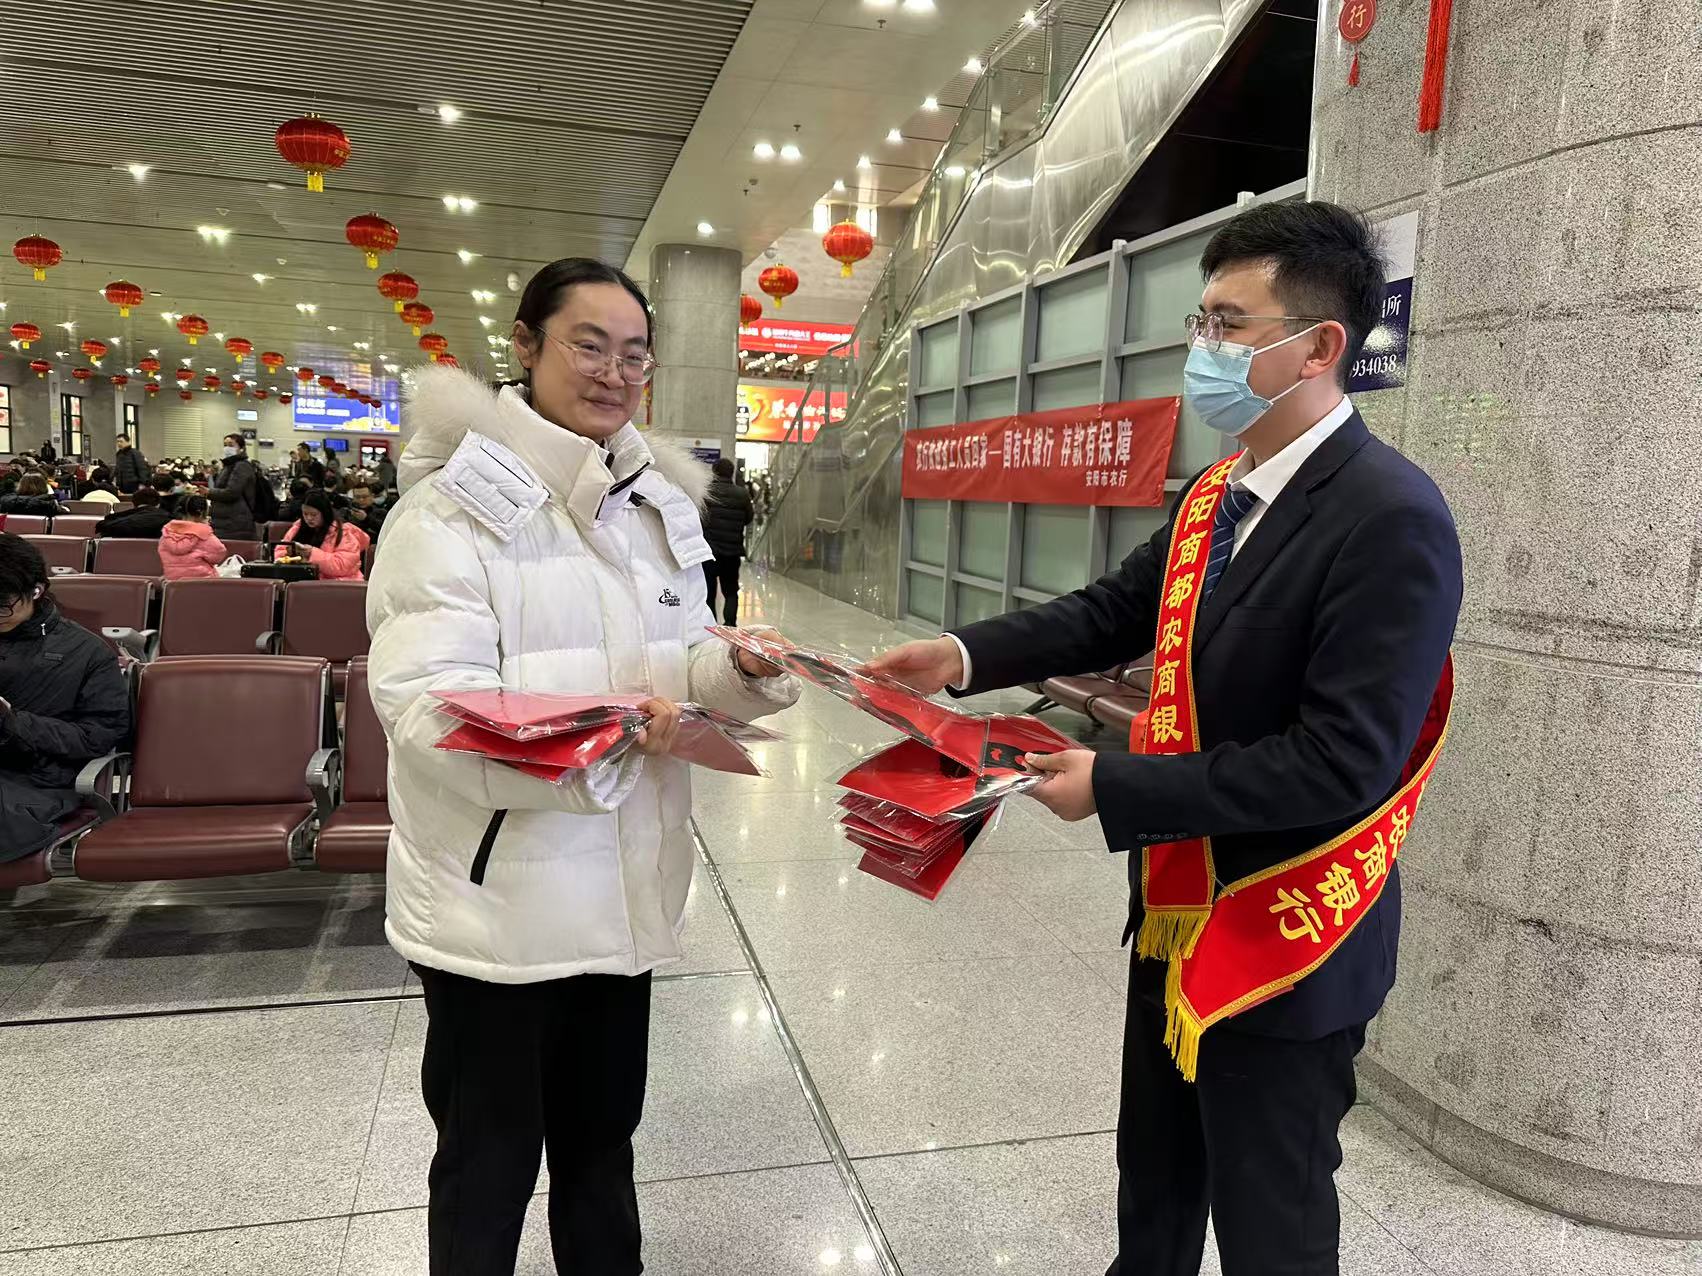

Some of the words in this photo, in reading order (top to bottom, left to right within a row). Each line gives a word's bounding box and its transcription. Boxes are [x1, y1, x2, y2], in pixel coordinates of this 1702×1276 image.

[1347, 4, 1367, 28] 行
[1381, 294, 1402, 318] 所
[1350, 355, 1397, 378] 934038
[1060, 418, 1133, 468] 存款有保障
[1085, 470, 1128, 487] 安阳市农行
[1151, 459, 1236, 755] 安阳商都农商银
[1268, 780, 1425, 943] 农商银行
